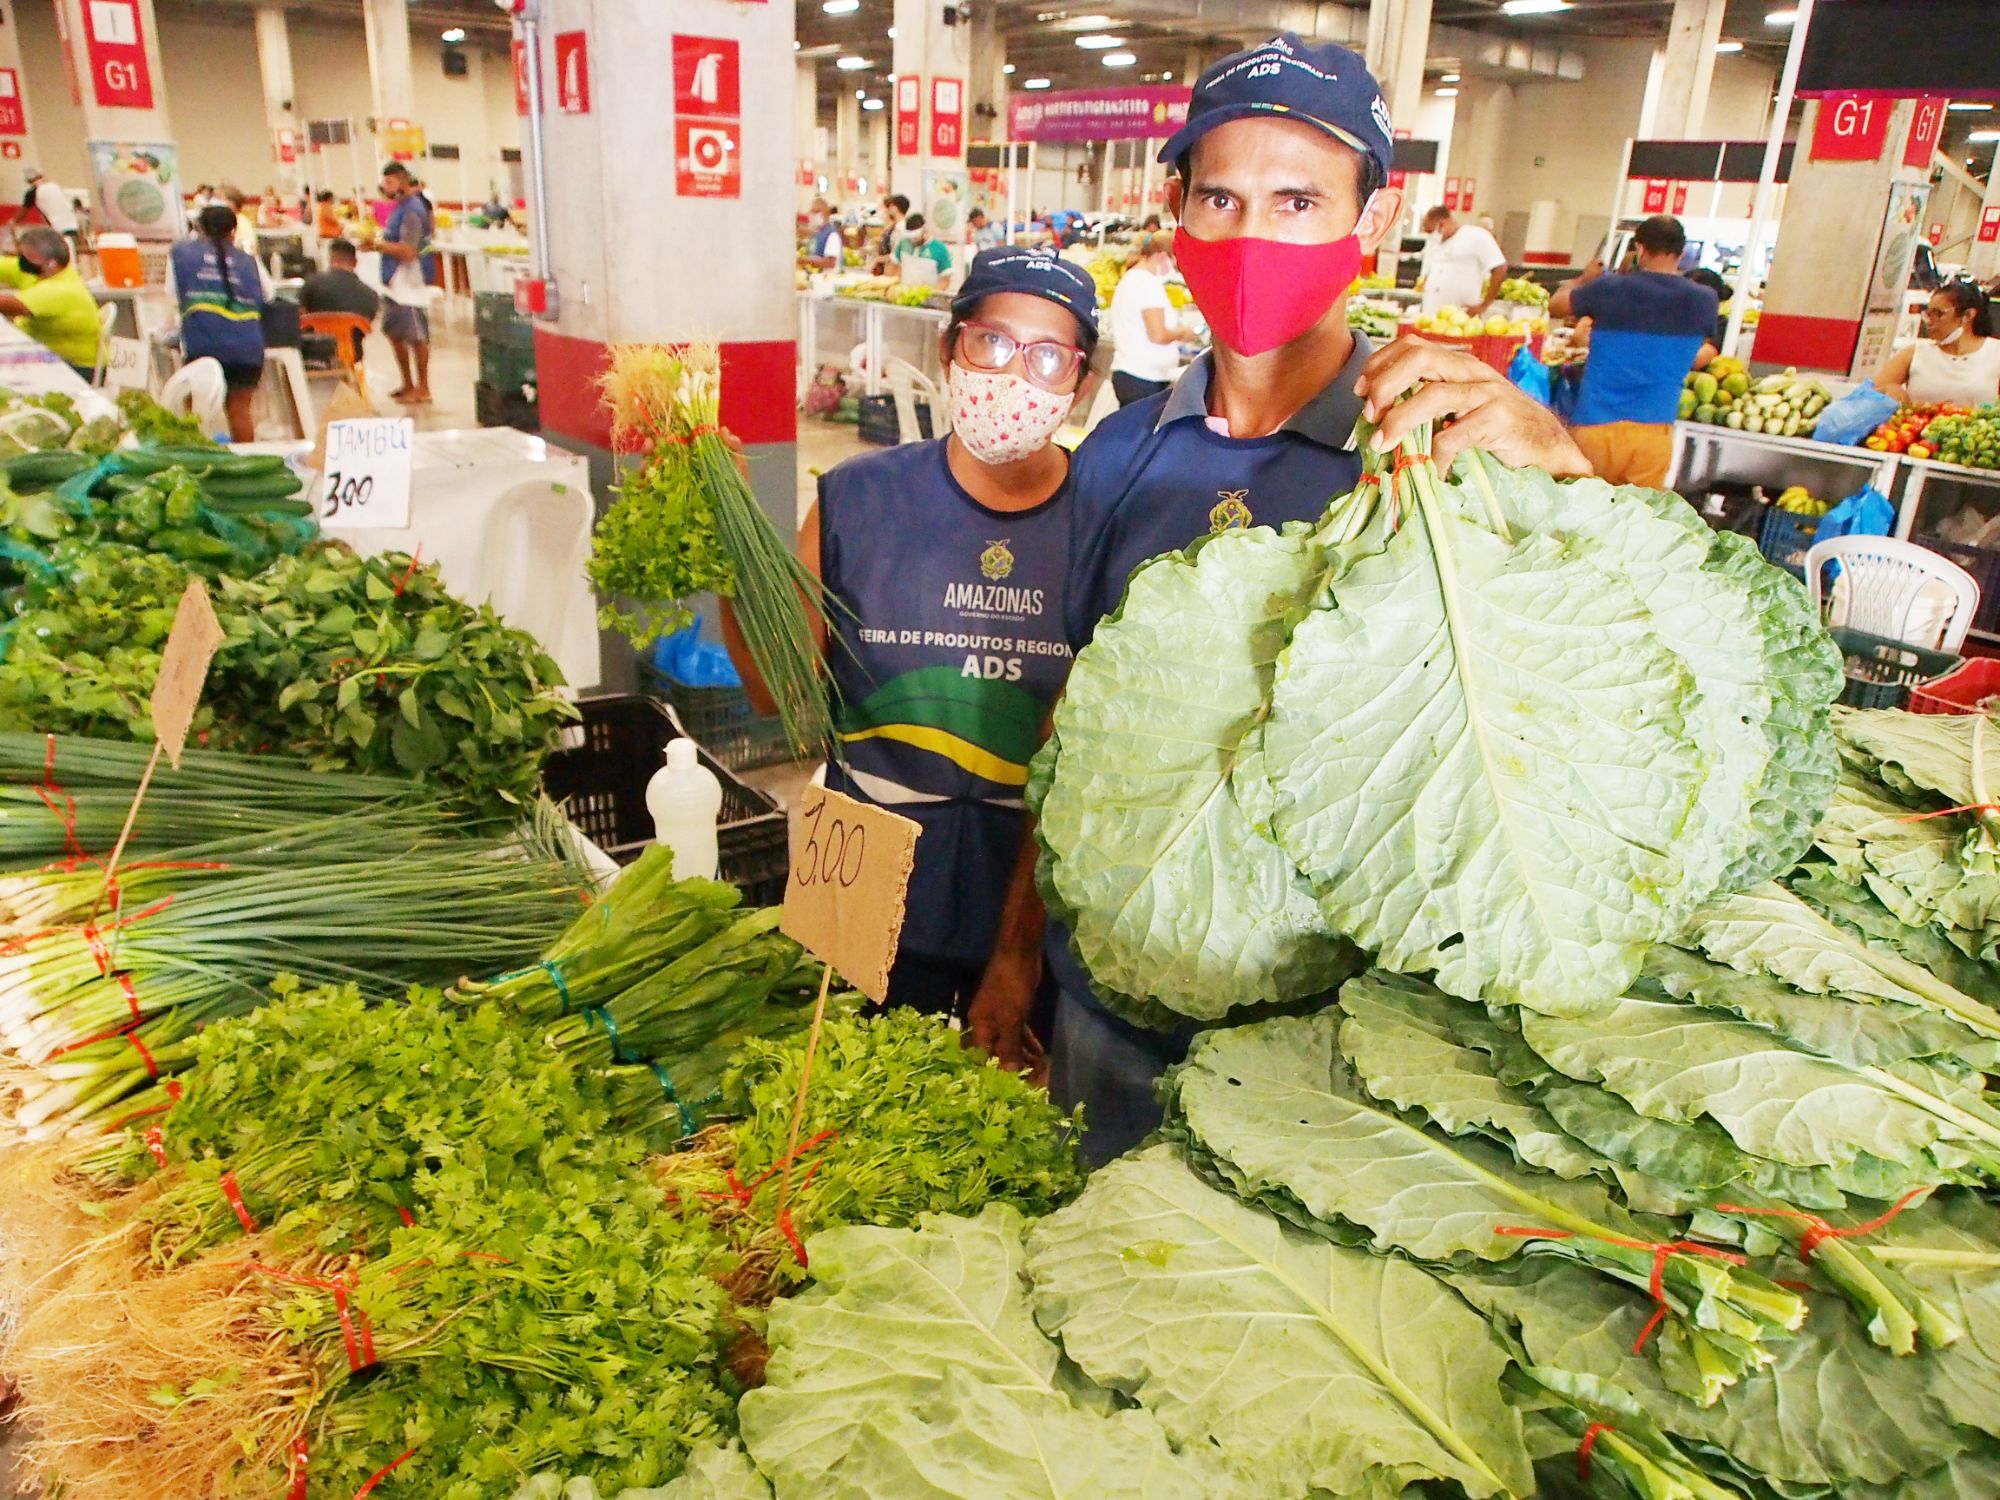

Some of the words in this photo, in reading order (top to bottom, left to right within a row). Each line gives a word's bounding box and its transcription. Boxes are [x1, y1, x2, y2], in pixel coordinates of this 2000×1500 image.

[105, 60, 138, 91] G1
[1226, 66, 1236, 77] DE
[1236, 53, 1279, 71] PRODUTOS
[1280, 55, 1324, 79] REGIONAIS
[1247, 62, 1282, 79] ADS
[1833, 100, 1874, 136] G1
[1916, 105, 1936, 142] G1
[937, 122, 956, 147] G1
[1026, 260, 1052, 271] ADS
[943, 582, 1044, 616] AMAZONAS
[959, 610, 990, 619] GOVERNO
[1001, 614, 1025, 622] ESTADO
[859, 628, 897, 644] FEIRA
[900, 630, 921, 645] DE
[924, 631, 1013, 652] PRODUTOS
[961, 654, 1023, 682] ADS
